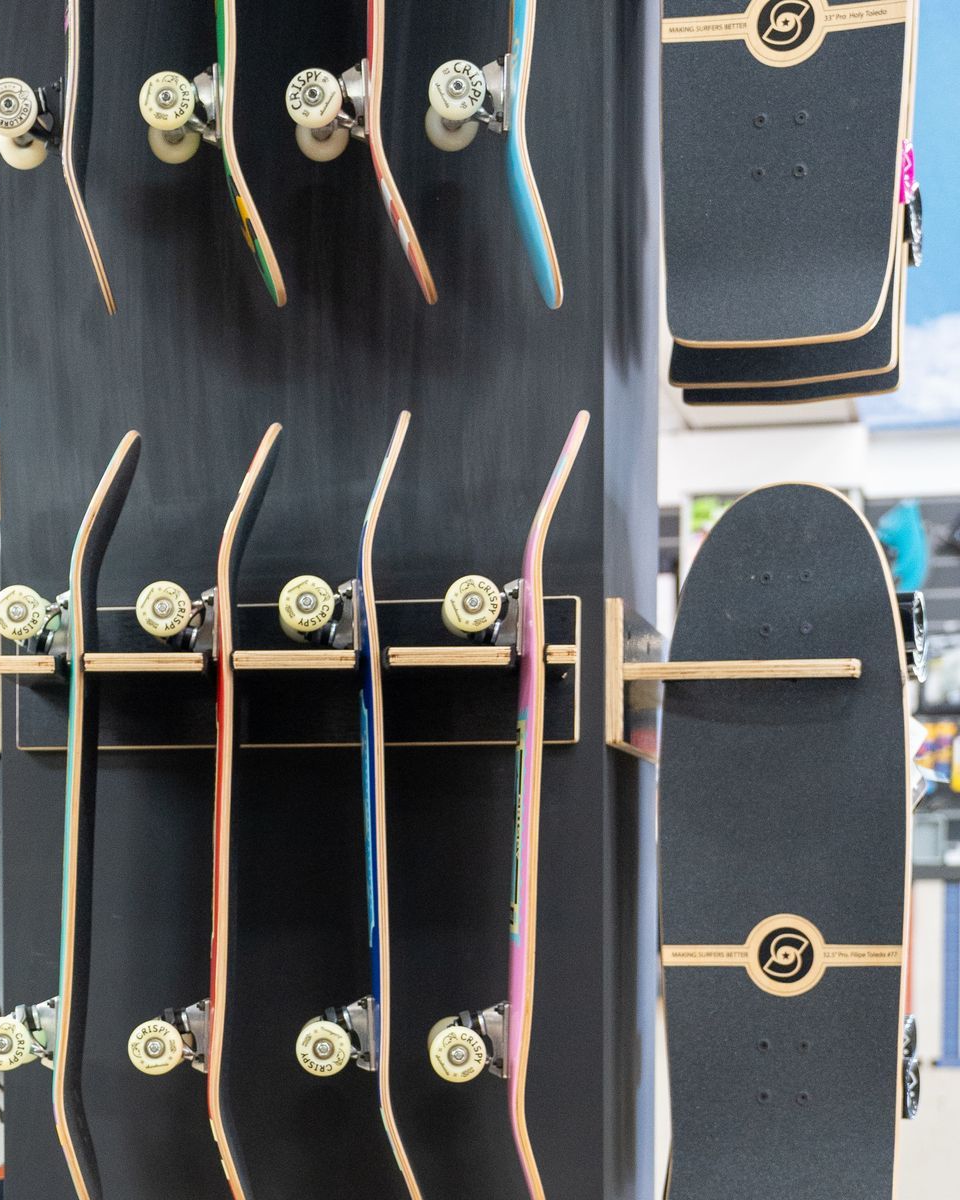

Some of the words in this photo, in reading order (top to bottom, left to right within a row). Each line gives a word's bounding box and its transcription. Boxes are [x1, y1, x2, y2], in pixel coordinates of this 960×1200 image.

[695, 24, 723, 32] SURFERS
[724, 22, 748, 30] BETTER
[289, 70, 322, 111] CRISPY
[453, 61, 482, 107] CRISPY
[174, 83, 190, 119] CRISPY
[478, 580, 498, 615] CRISPY
[12, 611, 40, 636] CRISPY
[164, 599, 187, 631] CRISPY
[298, 604, 330, 628] CRISPY
[136, 1024, 170, 1040] CRISPY
[8, 1032, 26, 1066] CRISPY
[301, 1052, 333, 1072] CRISPY
[460, 1032, 483, 1065] CRISPY
